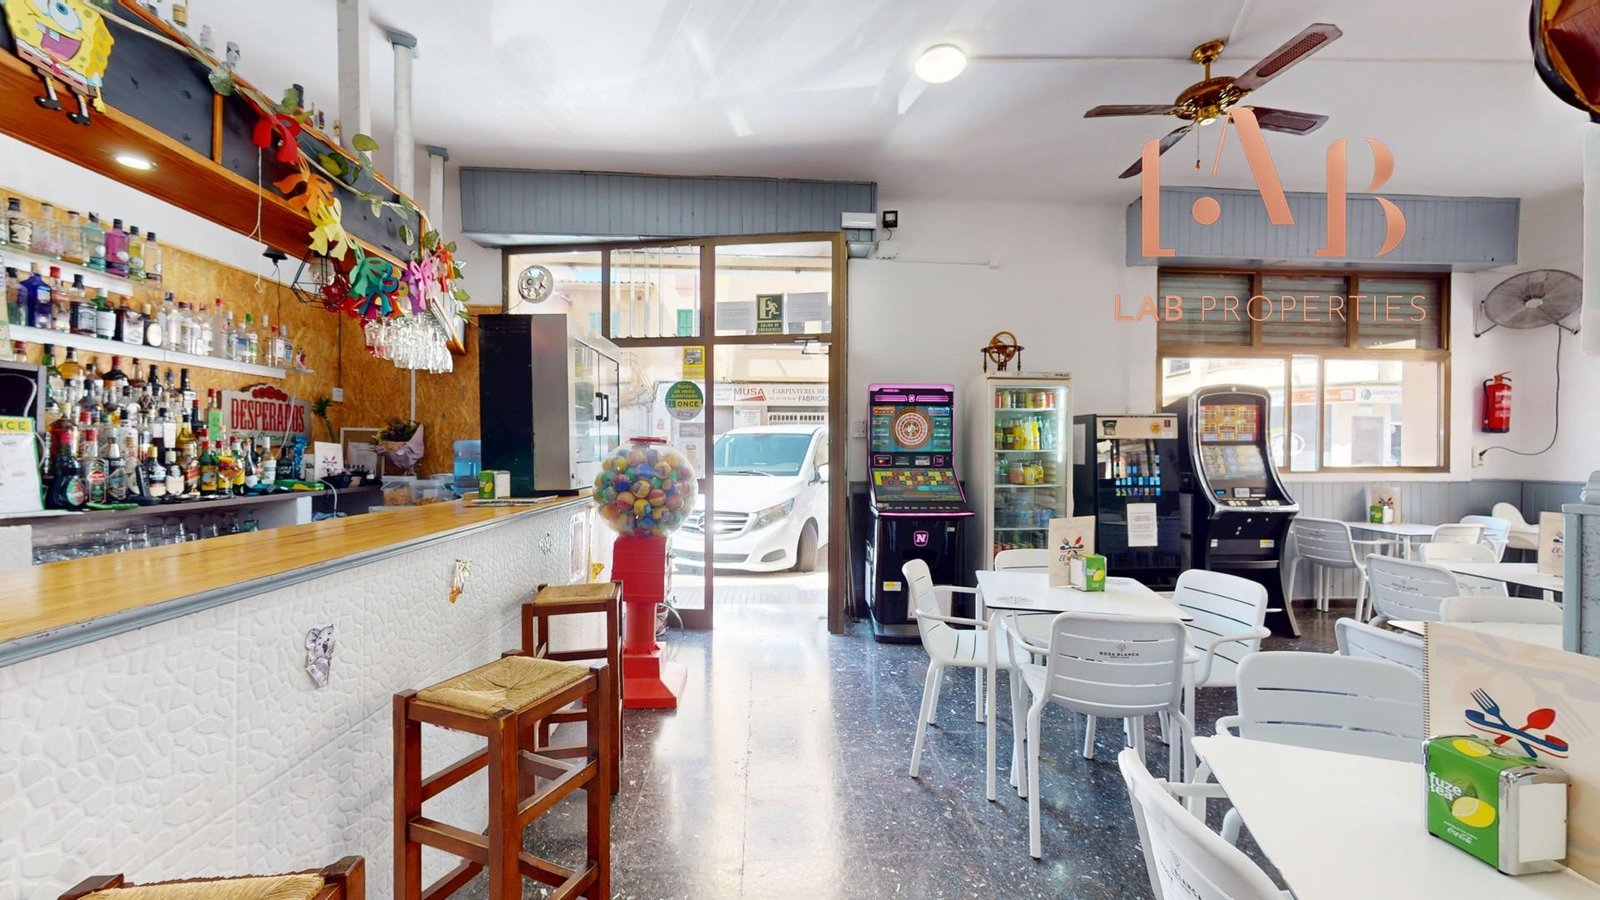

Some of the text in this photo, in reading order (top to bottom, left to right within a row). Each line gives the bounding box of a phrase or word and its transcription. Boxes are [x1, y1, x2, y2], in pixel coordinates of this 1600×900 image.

[734, 387, 765, 398] MUSA
[231, 398, 304, 432] DESPERADOS
[916, 533, 927, 543] N
[1429, 771, 1462, 796] fuze
[1430, 785, 1453, 801] tea
